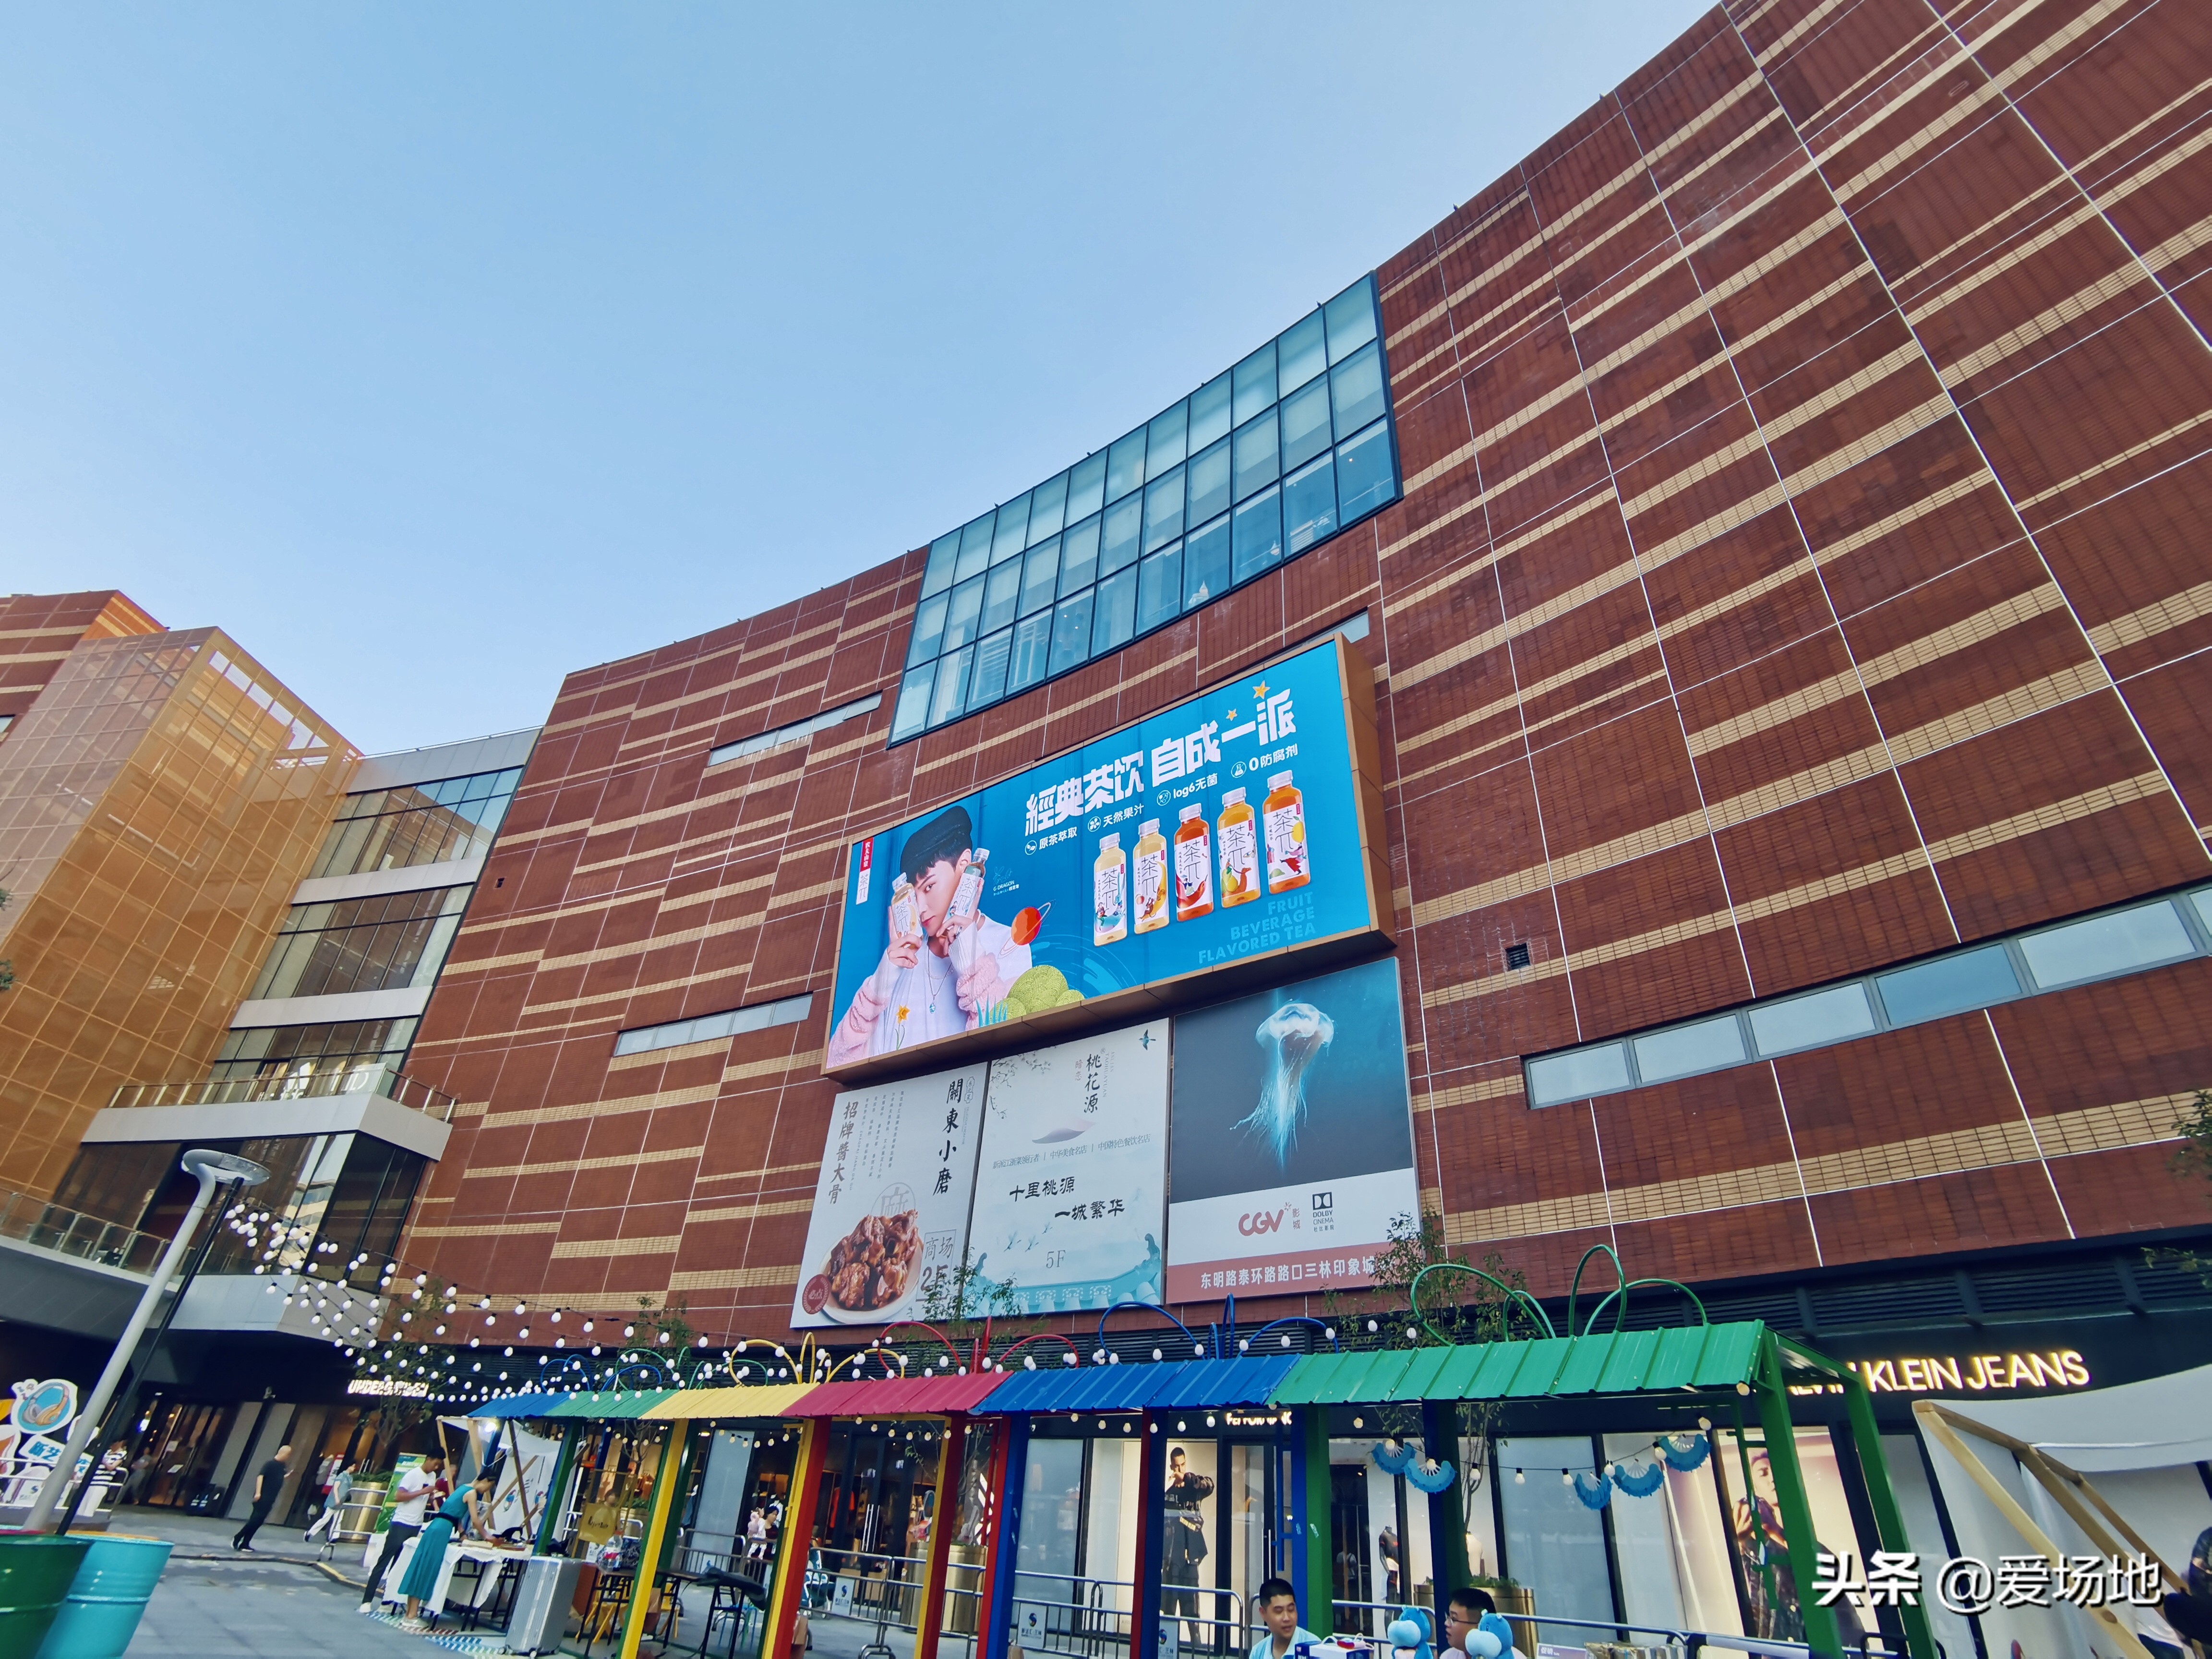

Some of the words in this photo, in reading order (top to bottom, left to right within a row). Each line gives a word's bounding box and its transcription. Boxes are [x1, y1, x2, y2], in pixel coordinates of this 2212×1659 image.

[1151, 688, 1296, 787] 自成一派
[1103, 803, 1144, 828] 天然果汁
[1039, 826, 1077, 850] 原茶萃取
[1268, 891, 1313, 915] FRUIT
[1230, 906, 1315, 940] BEVERAGE
[1198, 932, 1280, 964] FLAVORED
[1284, 922, 1316, 940] TEA
[1083, 1053, 1102, 1114] 桃花源
[933, 1078, 963, 1196] 關東小磨
[828, 1101, 859, 1204] 招牌醬大骨
[1009, 1176, 1075, 1202] 十里桃源
[1055, 1199, 1125, 1221] 一城繁华
[1292, 1208, 1300, 1230] 影城
[1312, 1209, 1333, 1218] DOLBY
[1313, 1217, 1334, 1225] CINEMA
[1238, 1209, 1284, 1237] CGV
[925, 1237, 953, 1261] 商场
[1046, 1250, 1066, 1269] 5F
[1863, 1357, 1964, 1393] KLEIN
[1967, 1351, 2091, 1391] JEANS
